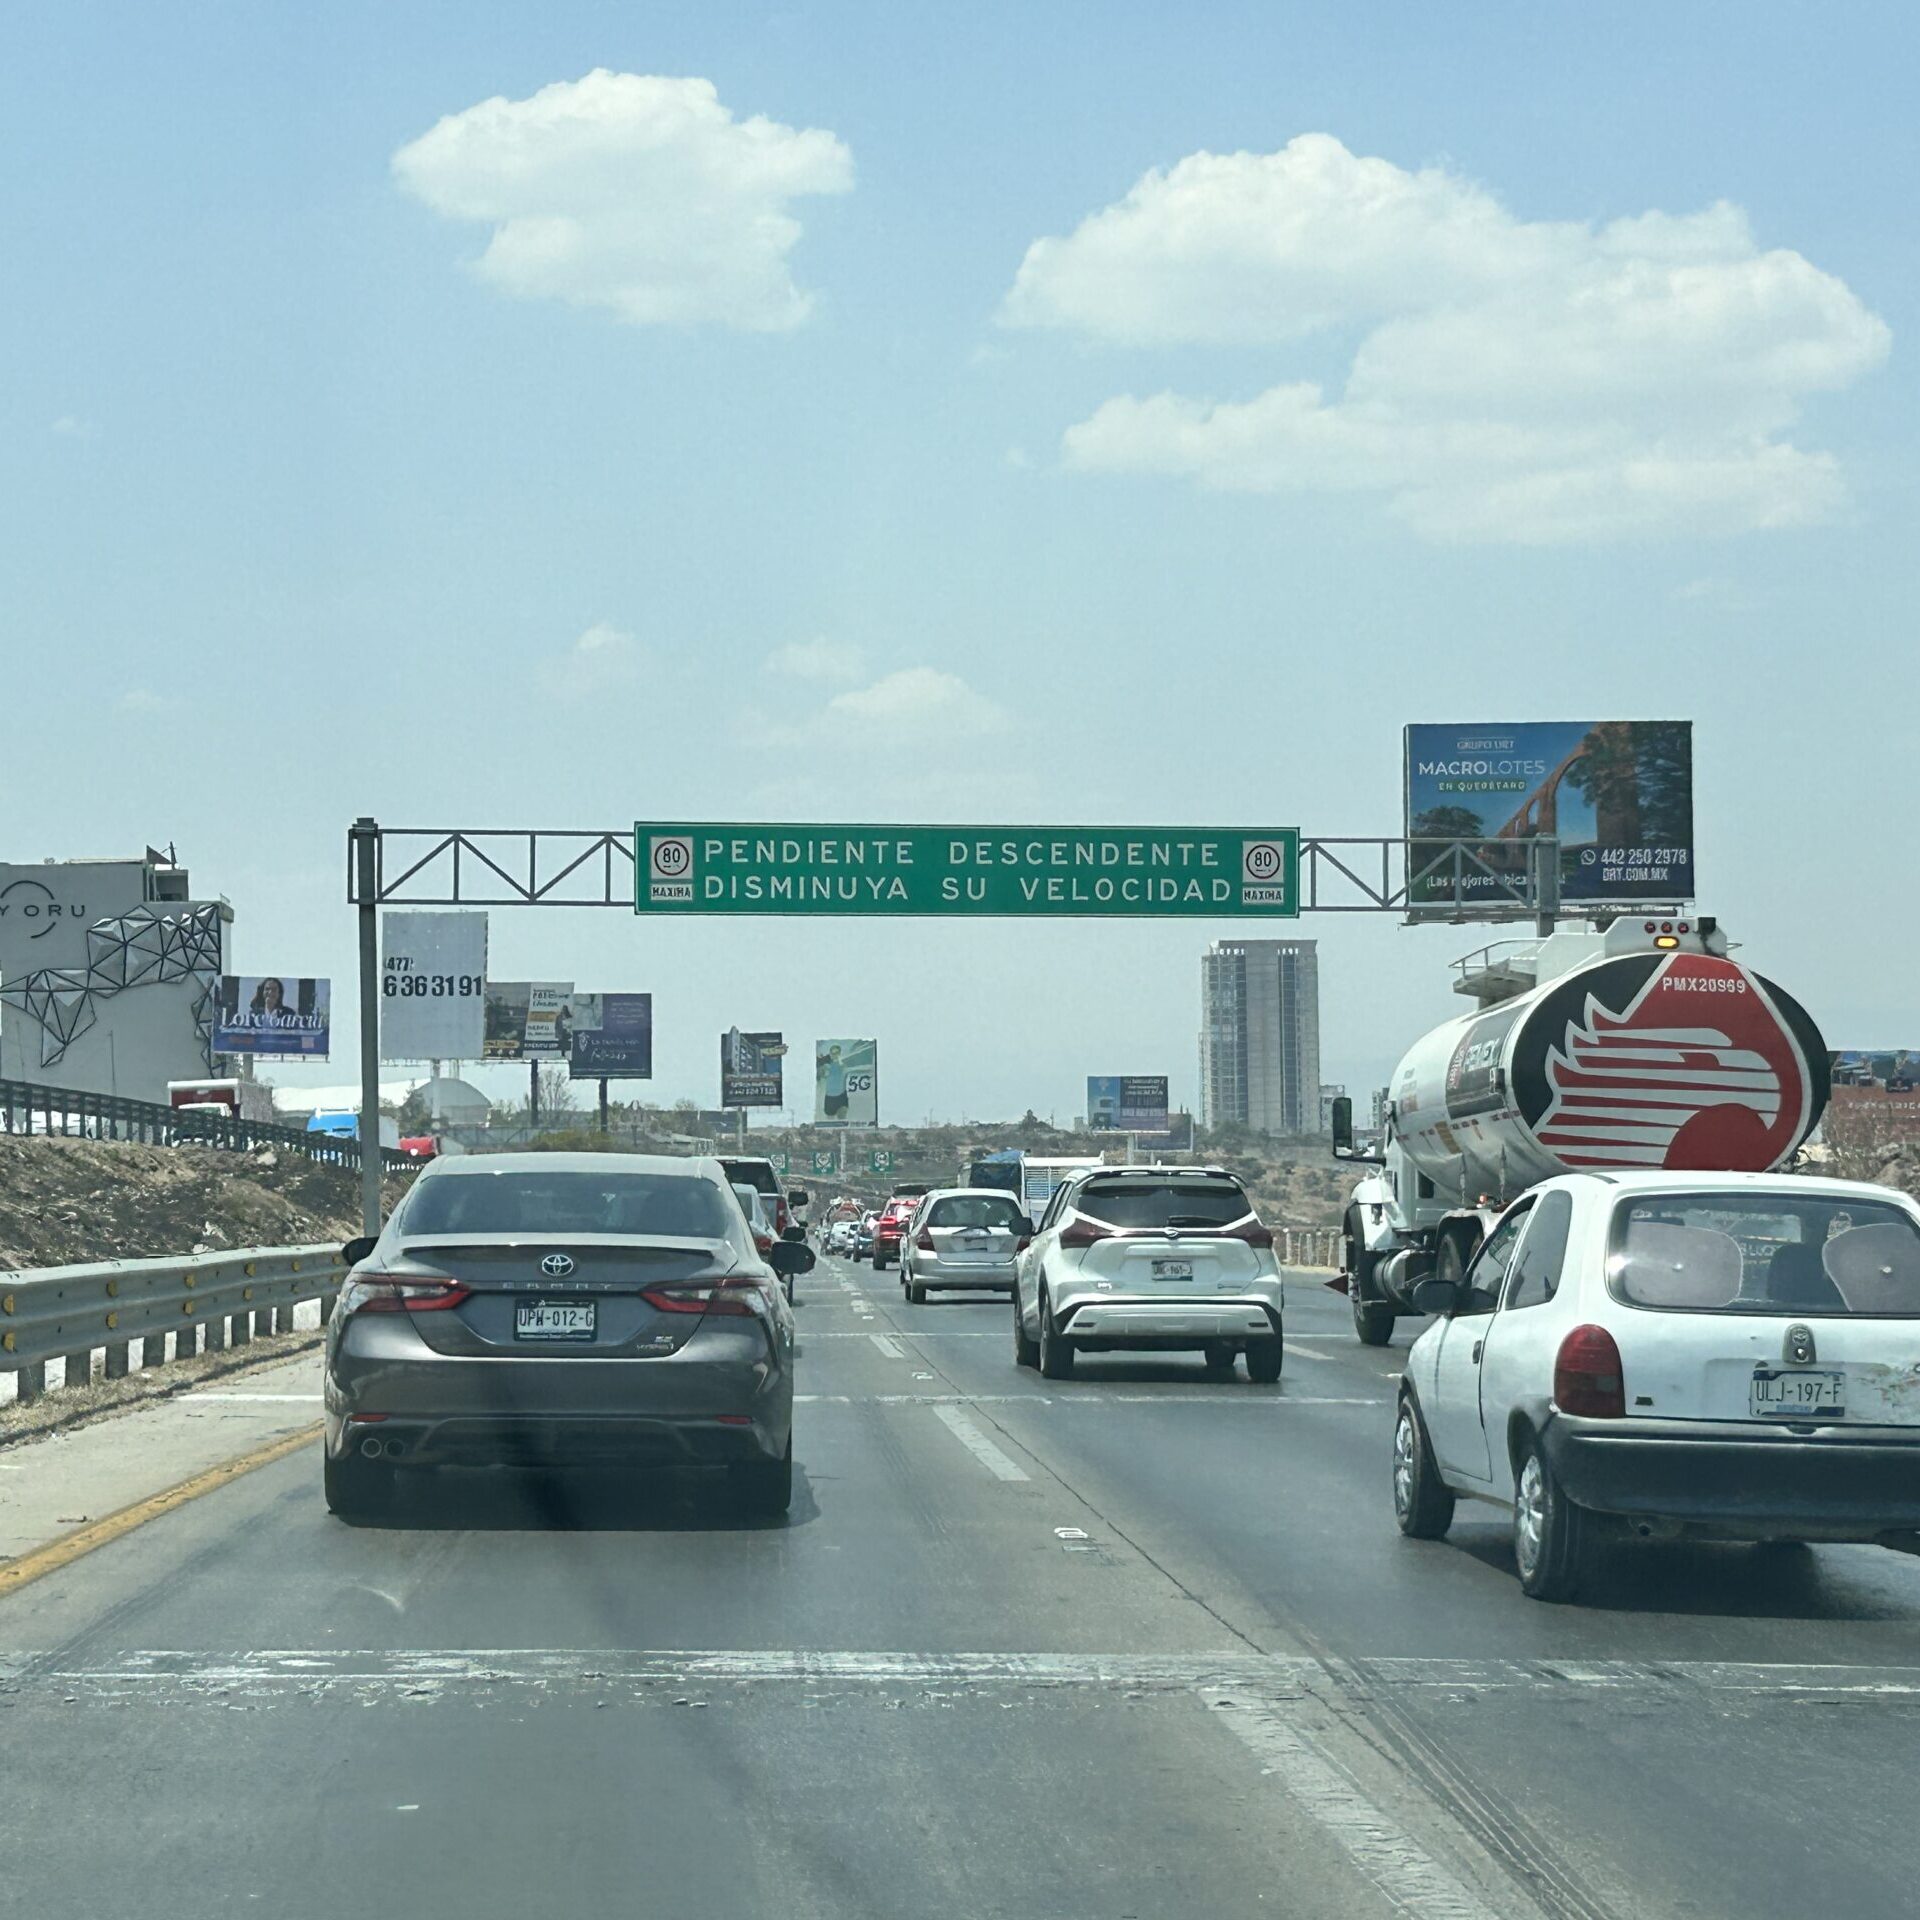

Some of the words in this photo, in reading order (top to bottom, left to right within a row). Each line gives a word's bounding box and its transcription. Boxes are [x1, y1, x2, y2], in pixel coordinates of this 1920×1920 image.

[1418, 760, 1546, 776] MACROLOTES
[663, 847, 681, 863] 80
[705, 839, 914, 864] PENDIENTE
[949, 842, 1219, 866] DESCENDENTE
[1254, 851, 1272, 867] 80
[1601, 848, 1625, 865] 442
[705, 876, 909, 900] DISMINUYA
[942, 877, 986, 901] SU
[1019, 878, 1231, 902] VELOCIDAD
[848, 1074, 872, 1093] 5G
[1755, 1381, 1843, 1404] ULJ-197-F
